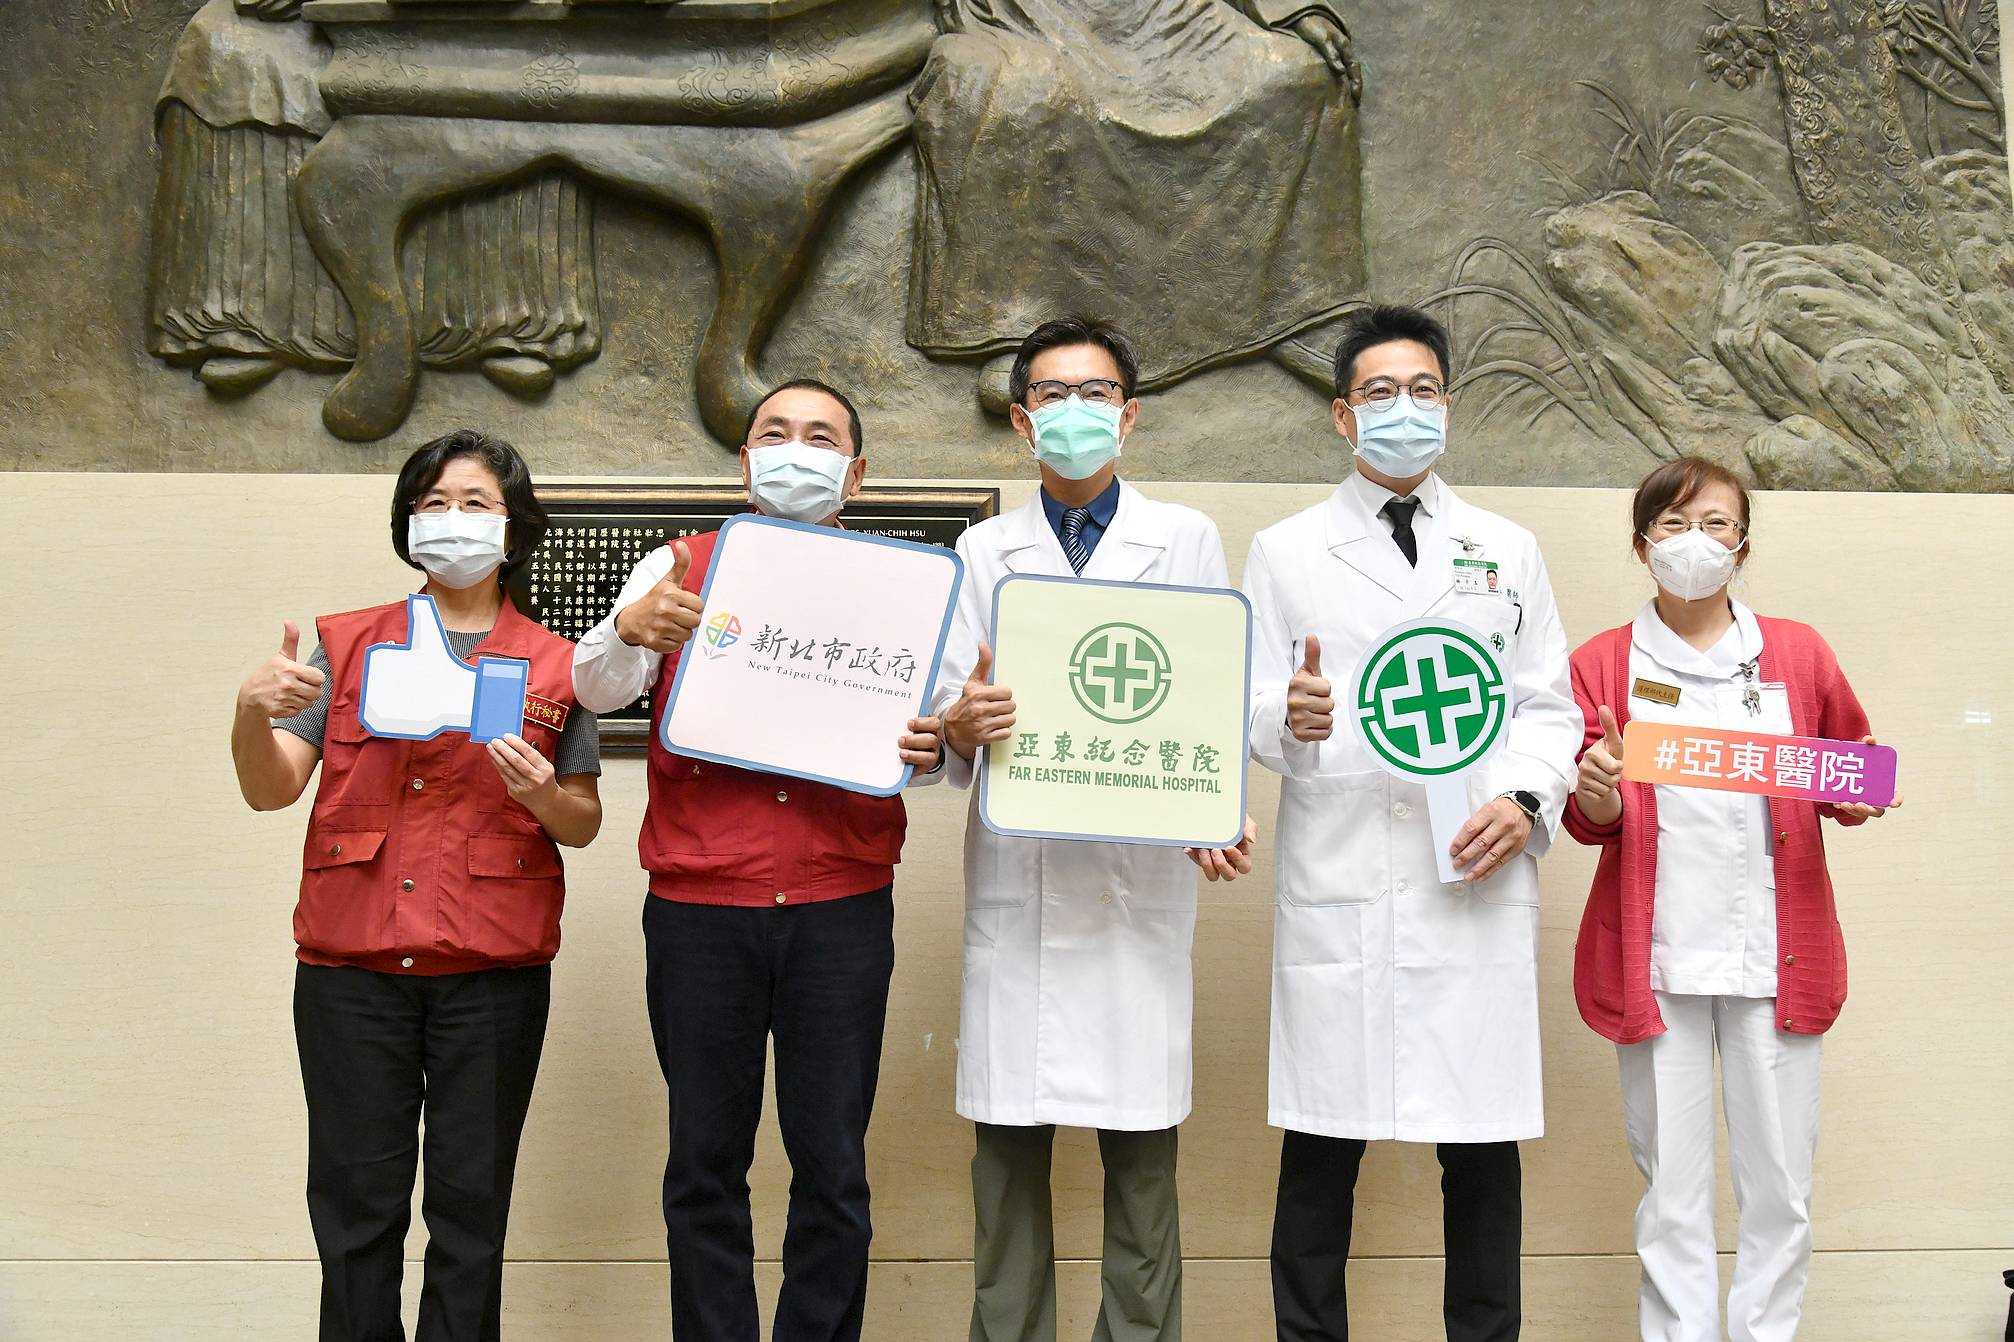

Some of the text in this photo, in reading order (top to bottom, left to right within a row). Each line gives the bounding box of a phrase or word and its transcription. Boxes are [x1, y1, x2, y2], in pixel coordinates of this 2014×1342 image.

[622, 528, 631, 582] 徐元智先生
[750, 624, 916, 684] 新北市政府
[748, 660, 912, 699] New Taipei City Government
[1013, 731, 1220, 774] 亞東紀念醫院
[1653, 736, 1865, 795] #亞東醫院
[1009, 765, 1221, 794] FAR EASTERN MEMORIAL HOSPITAL
